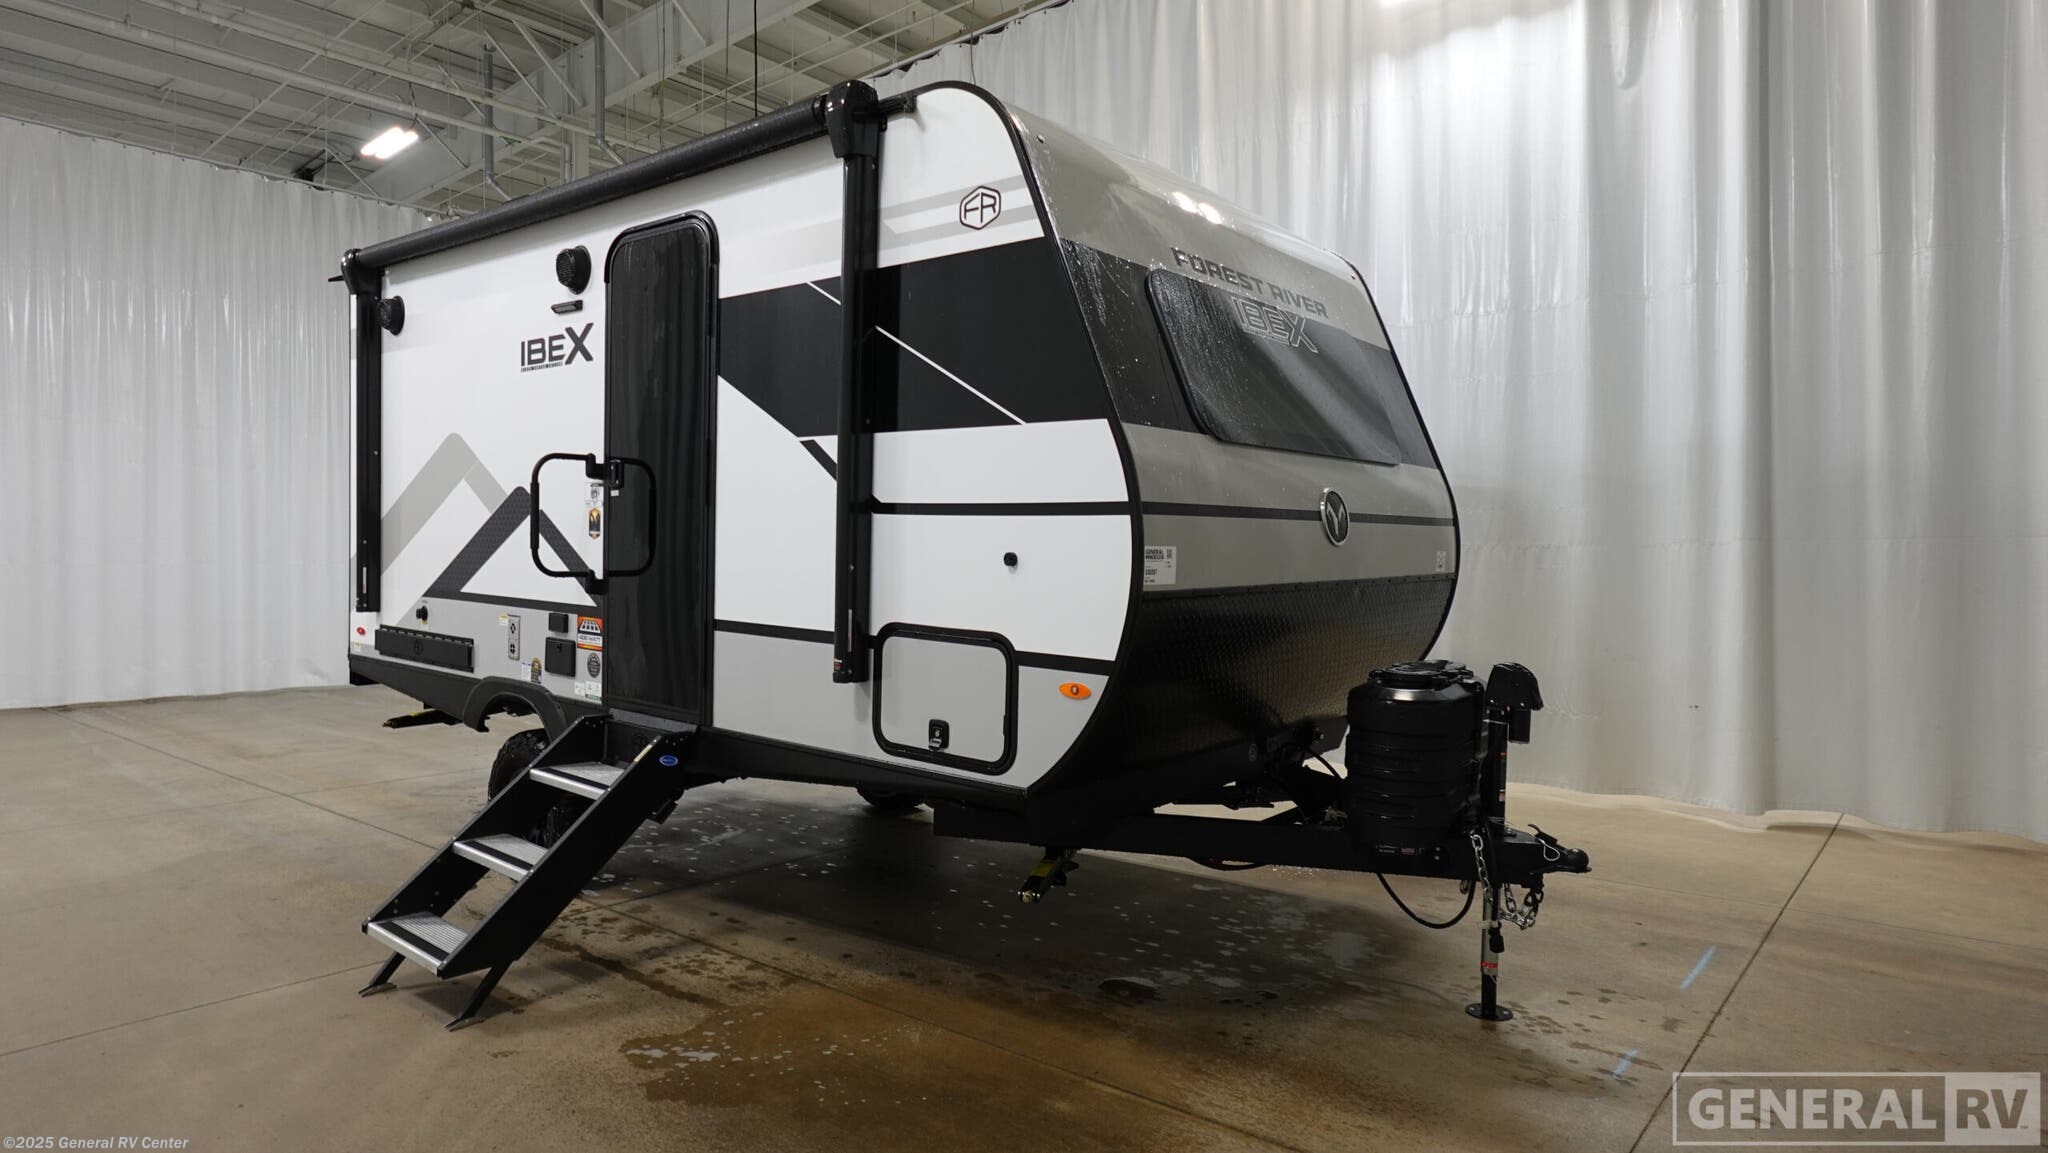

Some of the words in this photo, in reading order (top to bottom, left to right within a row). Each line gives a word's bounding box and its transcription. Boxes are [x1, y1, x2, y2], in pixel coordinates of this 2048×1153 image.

[963, 192, 996, 223] FR
[1170, 247, 1264, 295] FOREST
[1266, 281, 1329, 319] RIVER
[521, 322, 594, 366] IBEX
[1231, 296, 1320, 354] IBEX
